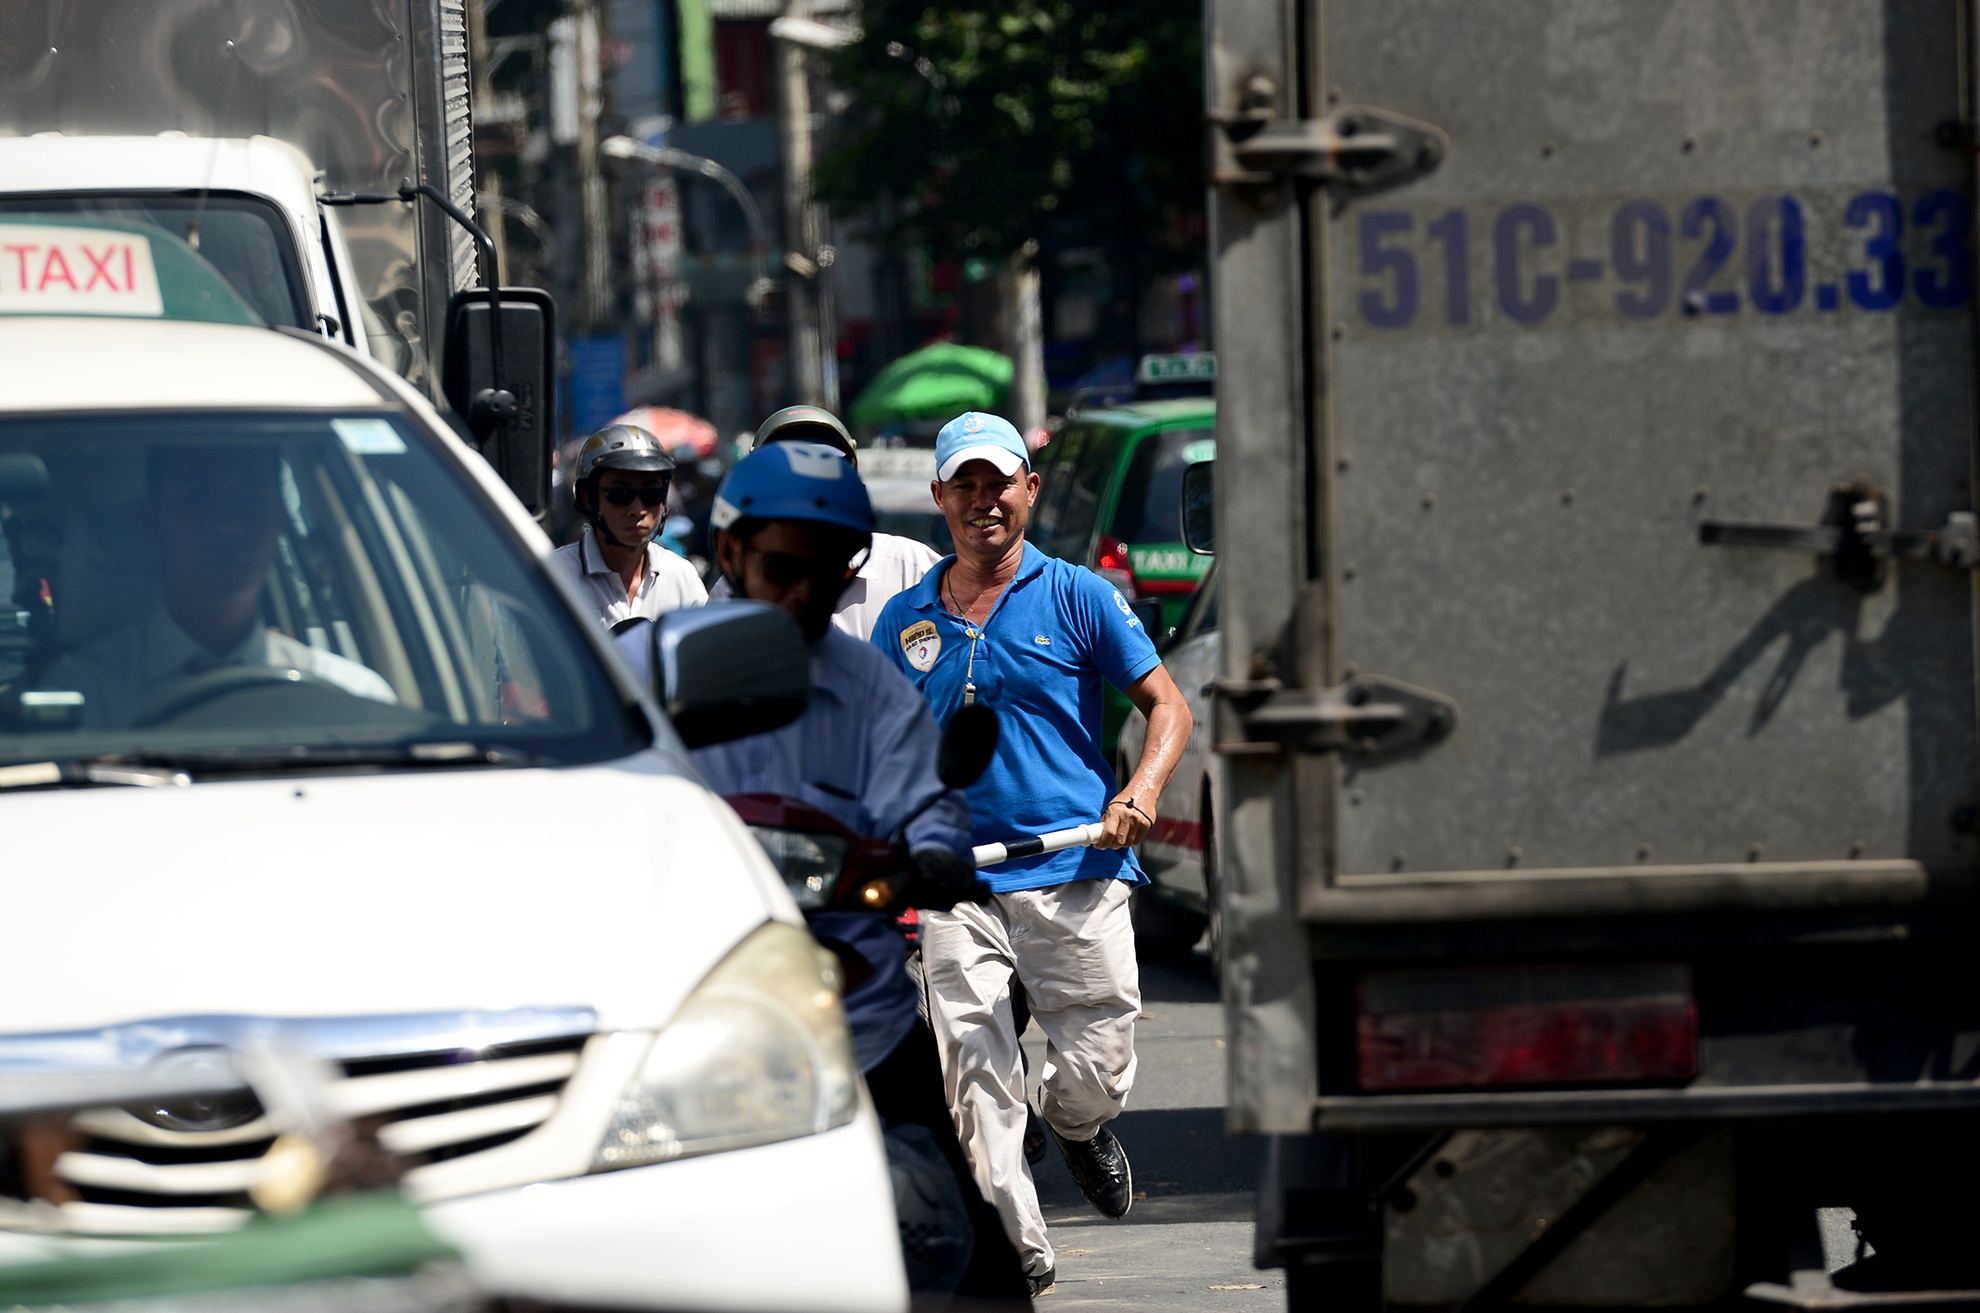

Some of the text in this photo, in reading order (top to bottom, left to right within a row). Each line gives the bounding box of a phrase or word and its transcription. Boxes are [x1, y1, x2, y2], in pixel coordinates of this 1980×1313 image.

[3, 244, 135, 292] TAXI
[1356, 189, 1971, 328] 51C-920.33
[1132, 550, 1188, 571] TAXI
